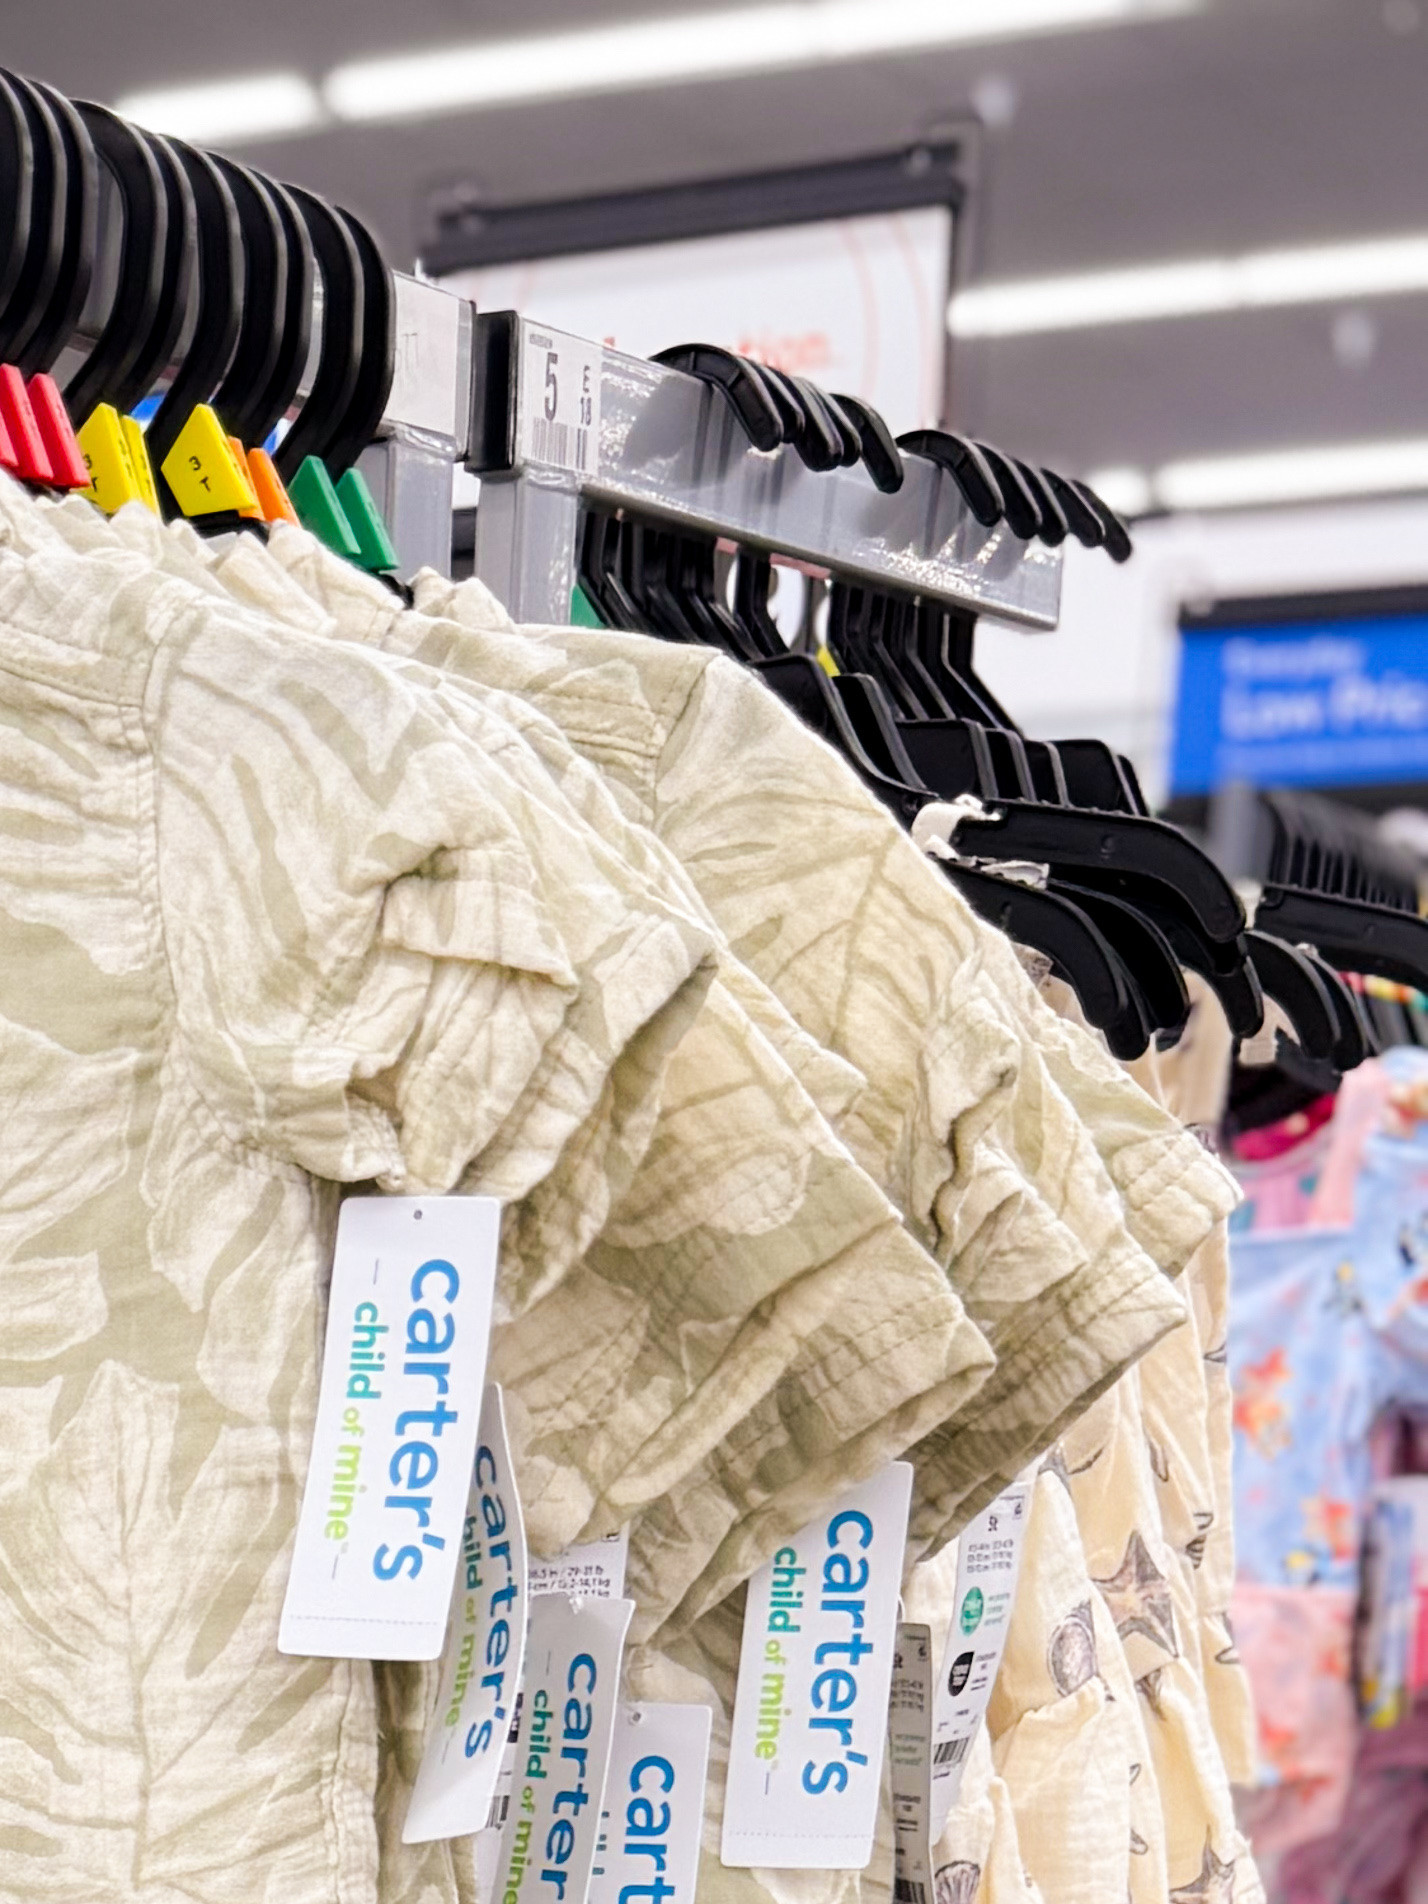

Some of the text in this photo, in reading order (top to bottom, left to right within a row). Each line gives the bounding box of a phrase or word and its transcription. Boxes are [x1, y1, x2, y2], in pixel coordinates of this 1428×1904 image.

[544, 351, 558, 422] 5
[188, 455, 202, 471] 3
[199, 476, 212, 493] T
[324, 1301, 390, 1541] child of mine
[373, 1259, 460, 1581] carter's
[461, 1512, 483, 1590] hild
[465, 1445, 518, 1758] carter's
[445, 1635, 475, 1727] mine
[754, 1546, 807, 1760] child of mine
[802, 1510, 874, 1795] carter's
[525, 1690, 553, 1779] child
[521, 1786, 536, 1812] of
